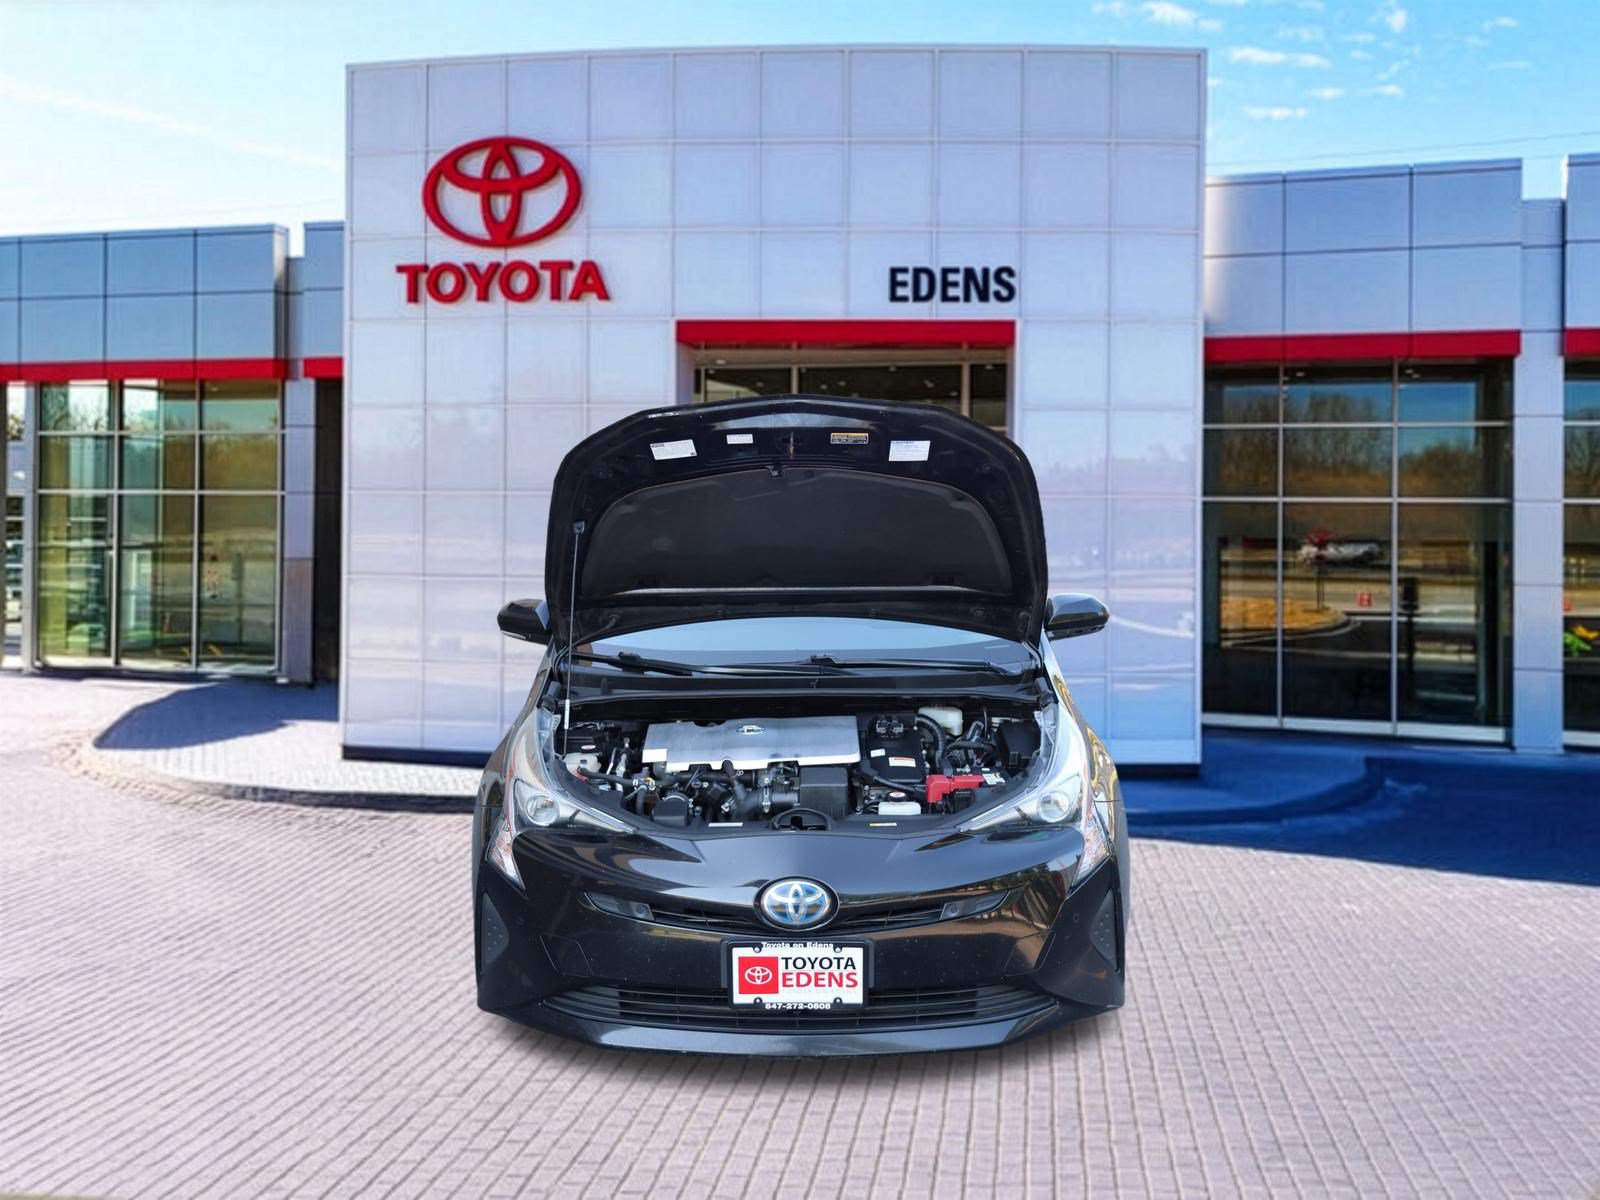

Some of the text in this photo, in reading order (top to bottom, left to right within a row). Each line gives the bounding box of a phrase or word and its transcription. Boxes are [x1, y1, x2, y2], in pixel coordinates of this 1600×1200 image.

[396, 260, 610, 303] TOYOTA
[889, 266, 1016, 303] EDENS
[781, 957, 856, 970] TOYOTA
[782, 972, 858, 988] EDENS
